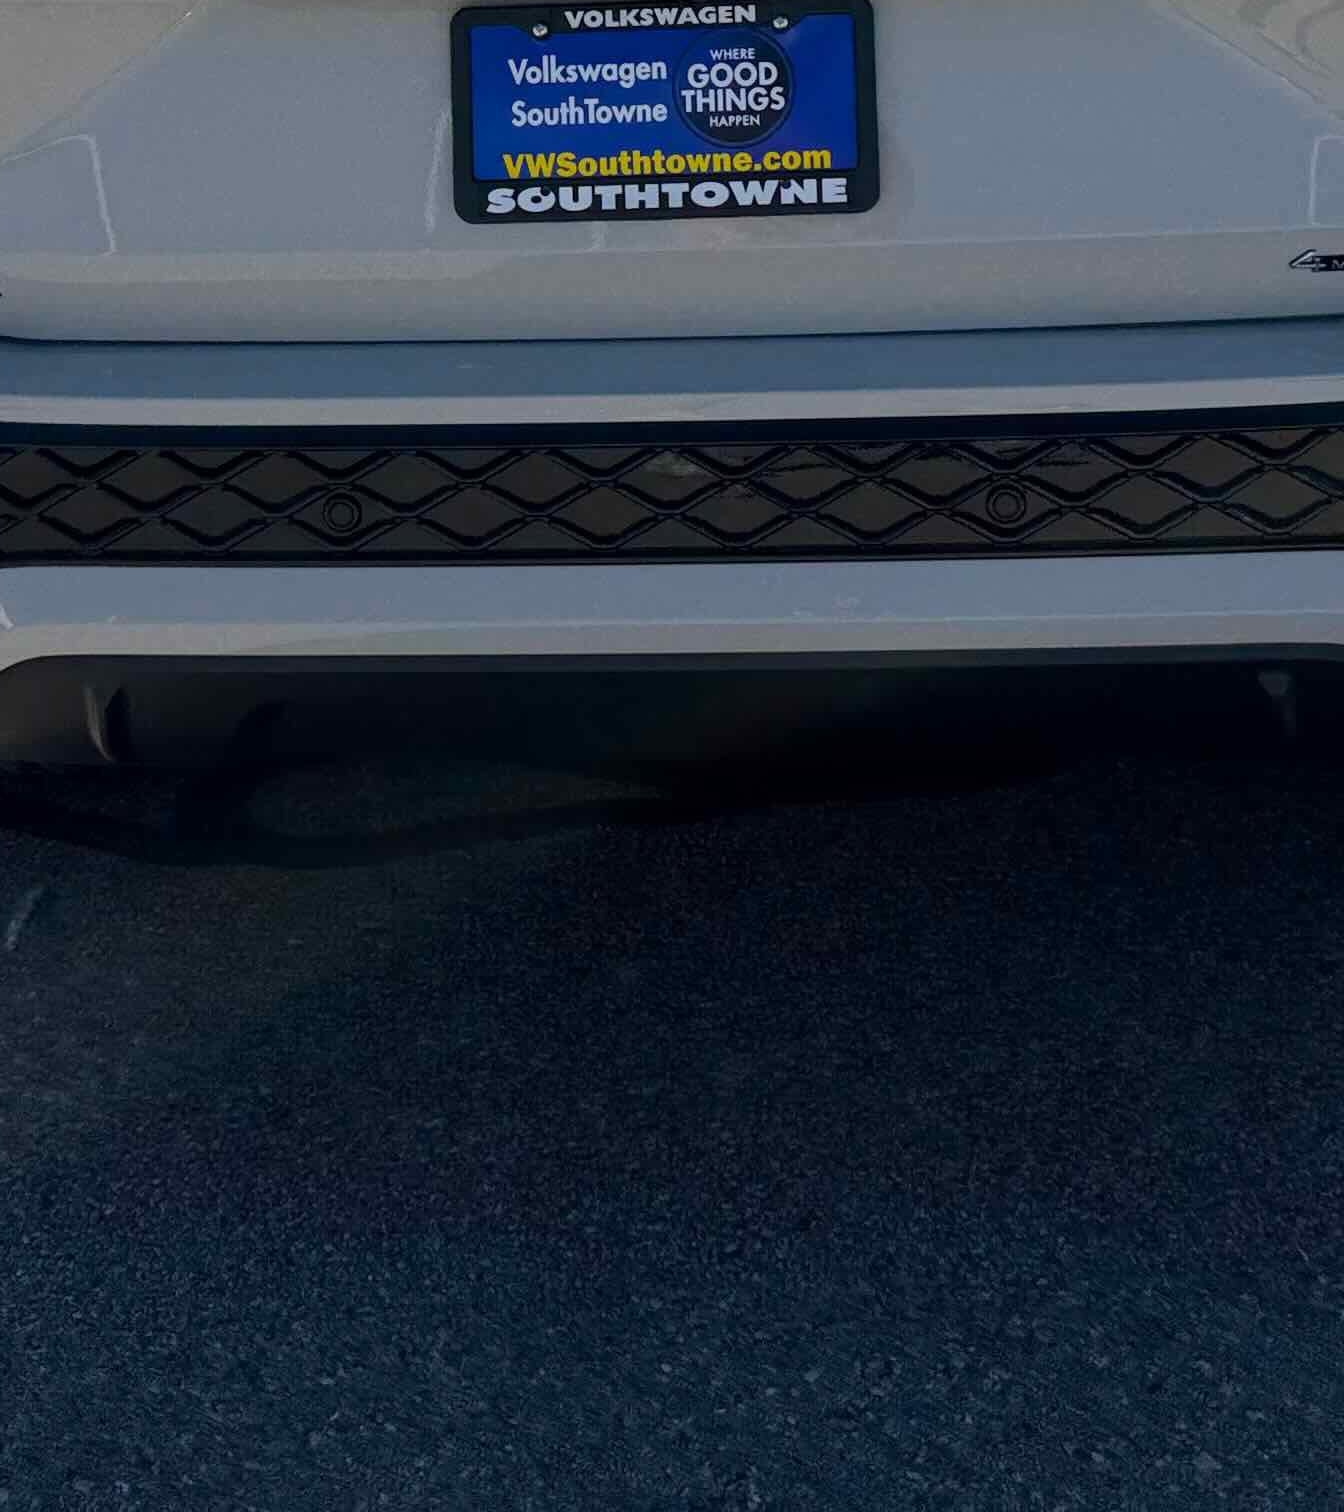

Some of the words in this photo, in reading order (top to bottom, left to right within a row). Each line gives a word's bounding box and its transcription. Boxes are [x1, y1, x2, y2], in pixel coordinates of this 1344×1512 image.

[564, 4, 757, 29] VOLKSWAGEN
[709, 48, 756, 60] WHERE
[507, 54, 667, 89] Volkswagen
[687, 61, 779, 88] GOOD
[511, 95, 668, 127] SouthTowne
[680, 86, 786, 113] THINGS
[709, 114, 761, 128] HAPPEN
[503, 148, 832, 179] VWSouthtowne.com
[486, 177, 849, 215] SOUTHTOWNE
